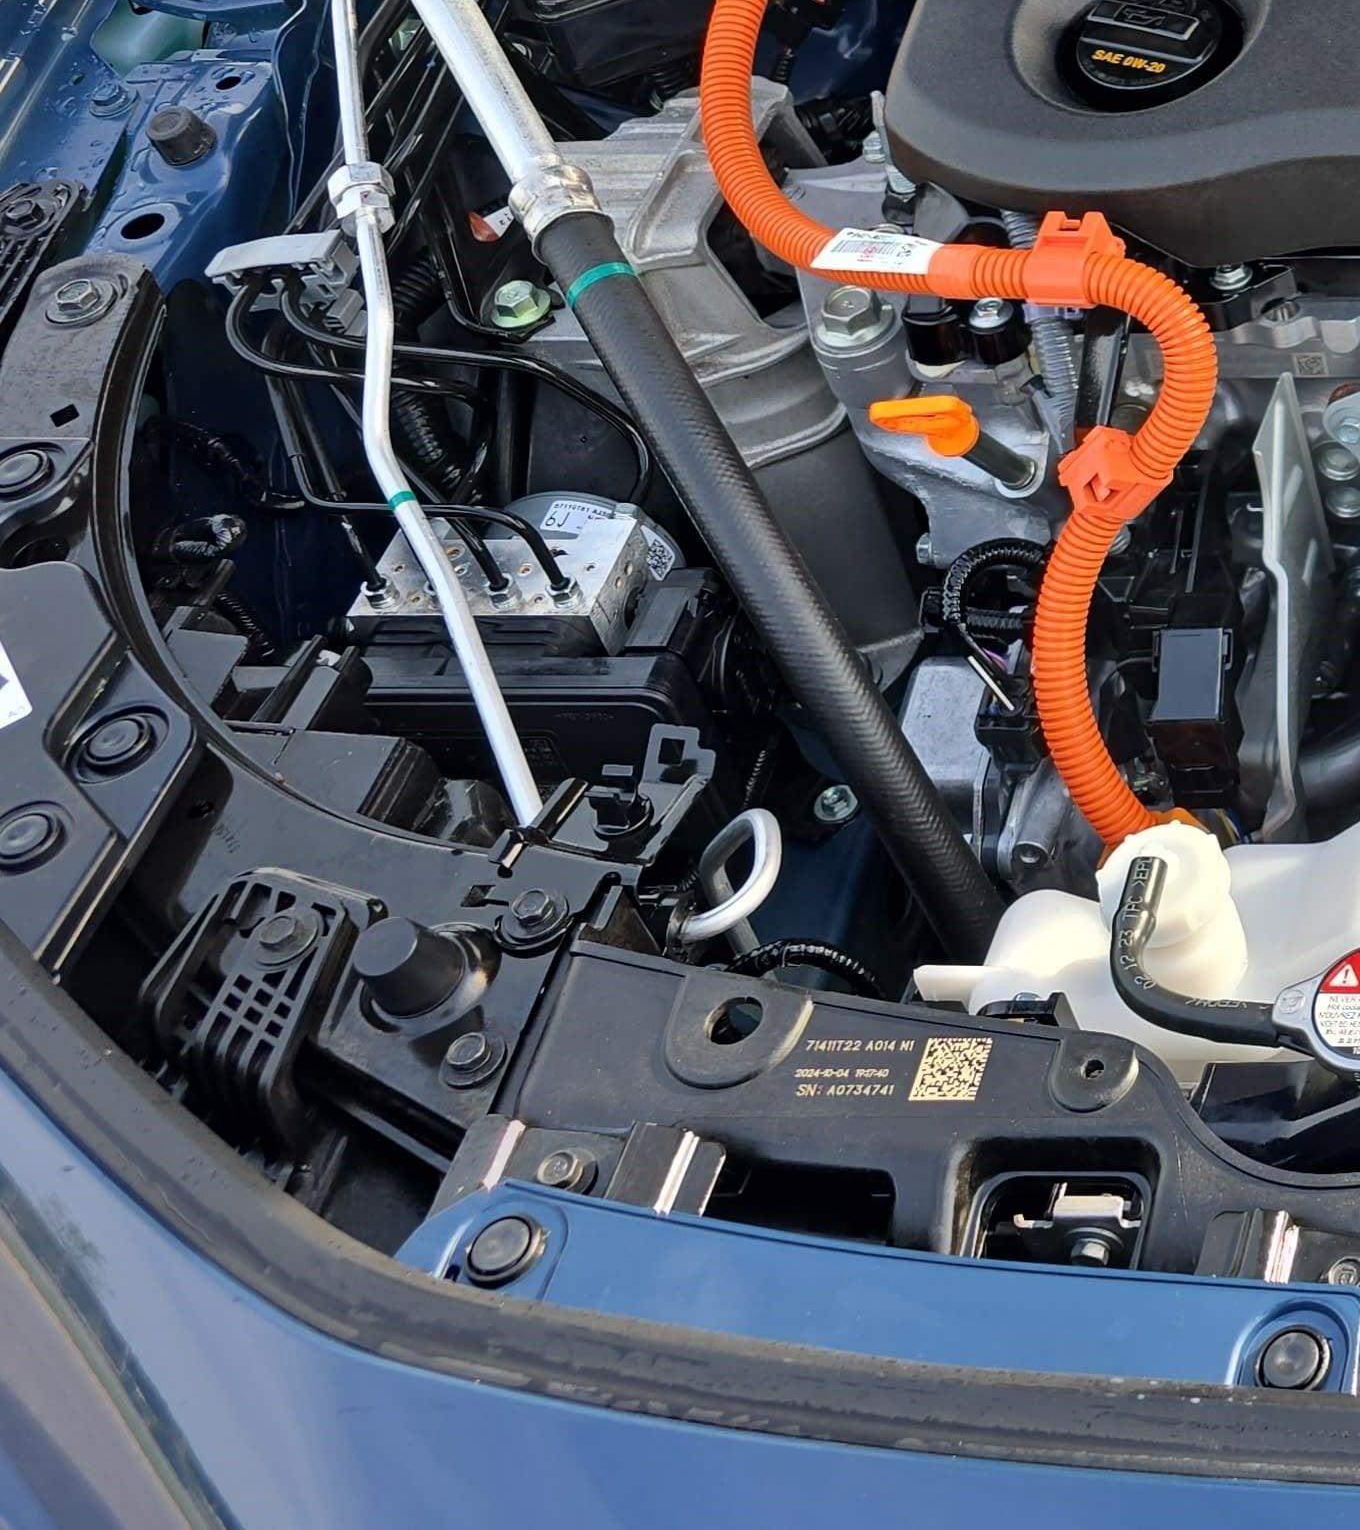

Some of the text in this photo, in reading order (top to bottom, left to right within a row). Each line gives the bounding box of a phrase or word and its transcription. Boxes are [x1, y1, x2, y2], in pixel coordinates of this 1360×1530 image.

[1092, 49, 1125, 64] SAE
[1122, 56, 1166, 74] 0W-20
[545, 510, 571, 528] 6J
[1118, 929, 1135, 947] 23
[806, 1040, 861, 1051] 71411T22
[865, 1040, 896, 1051] A014
[794, 1068, 850, 1078] 2024-10-04
[796, 1084, 895, 1096] SN: A0734741
